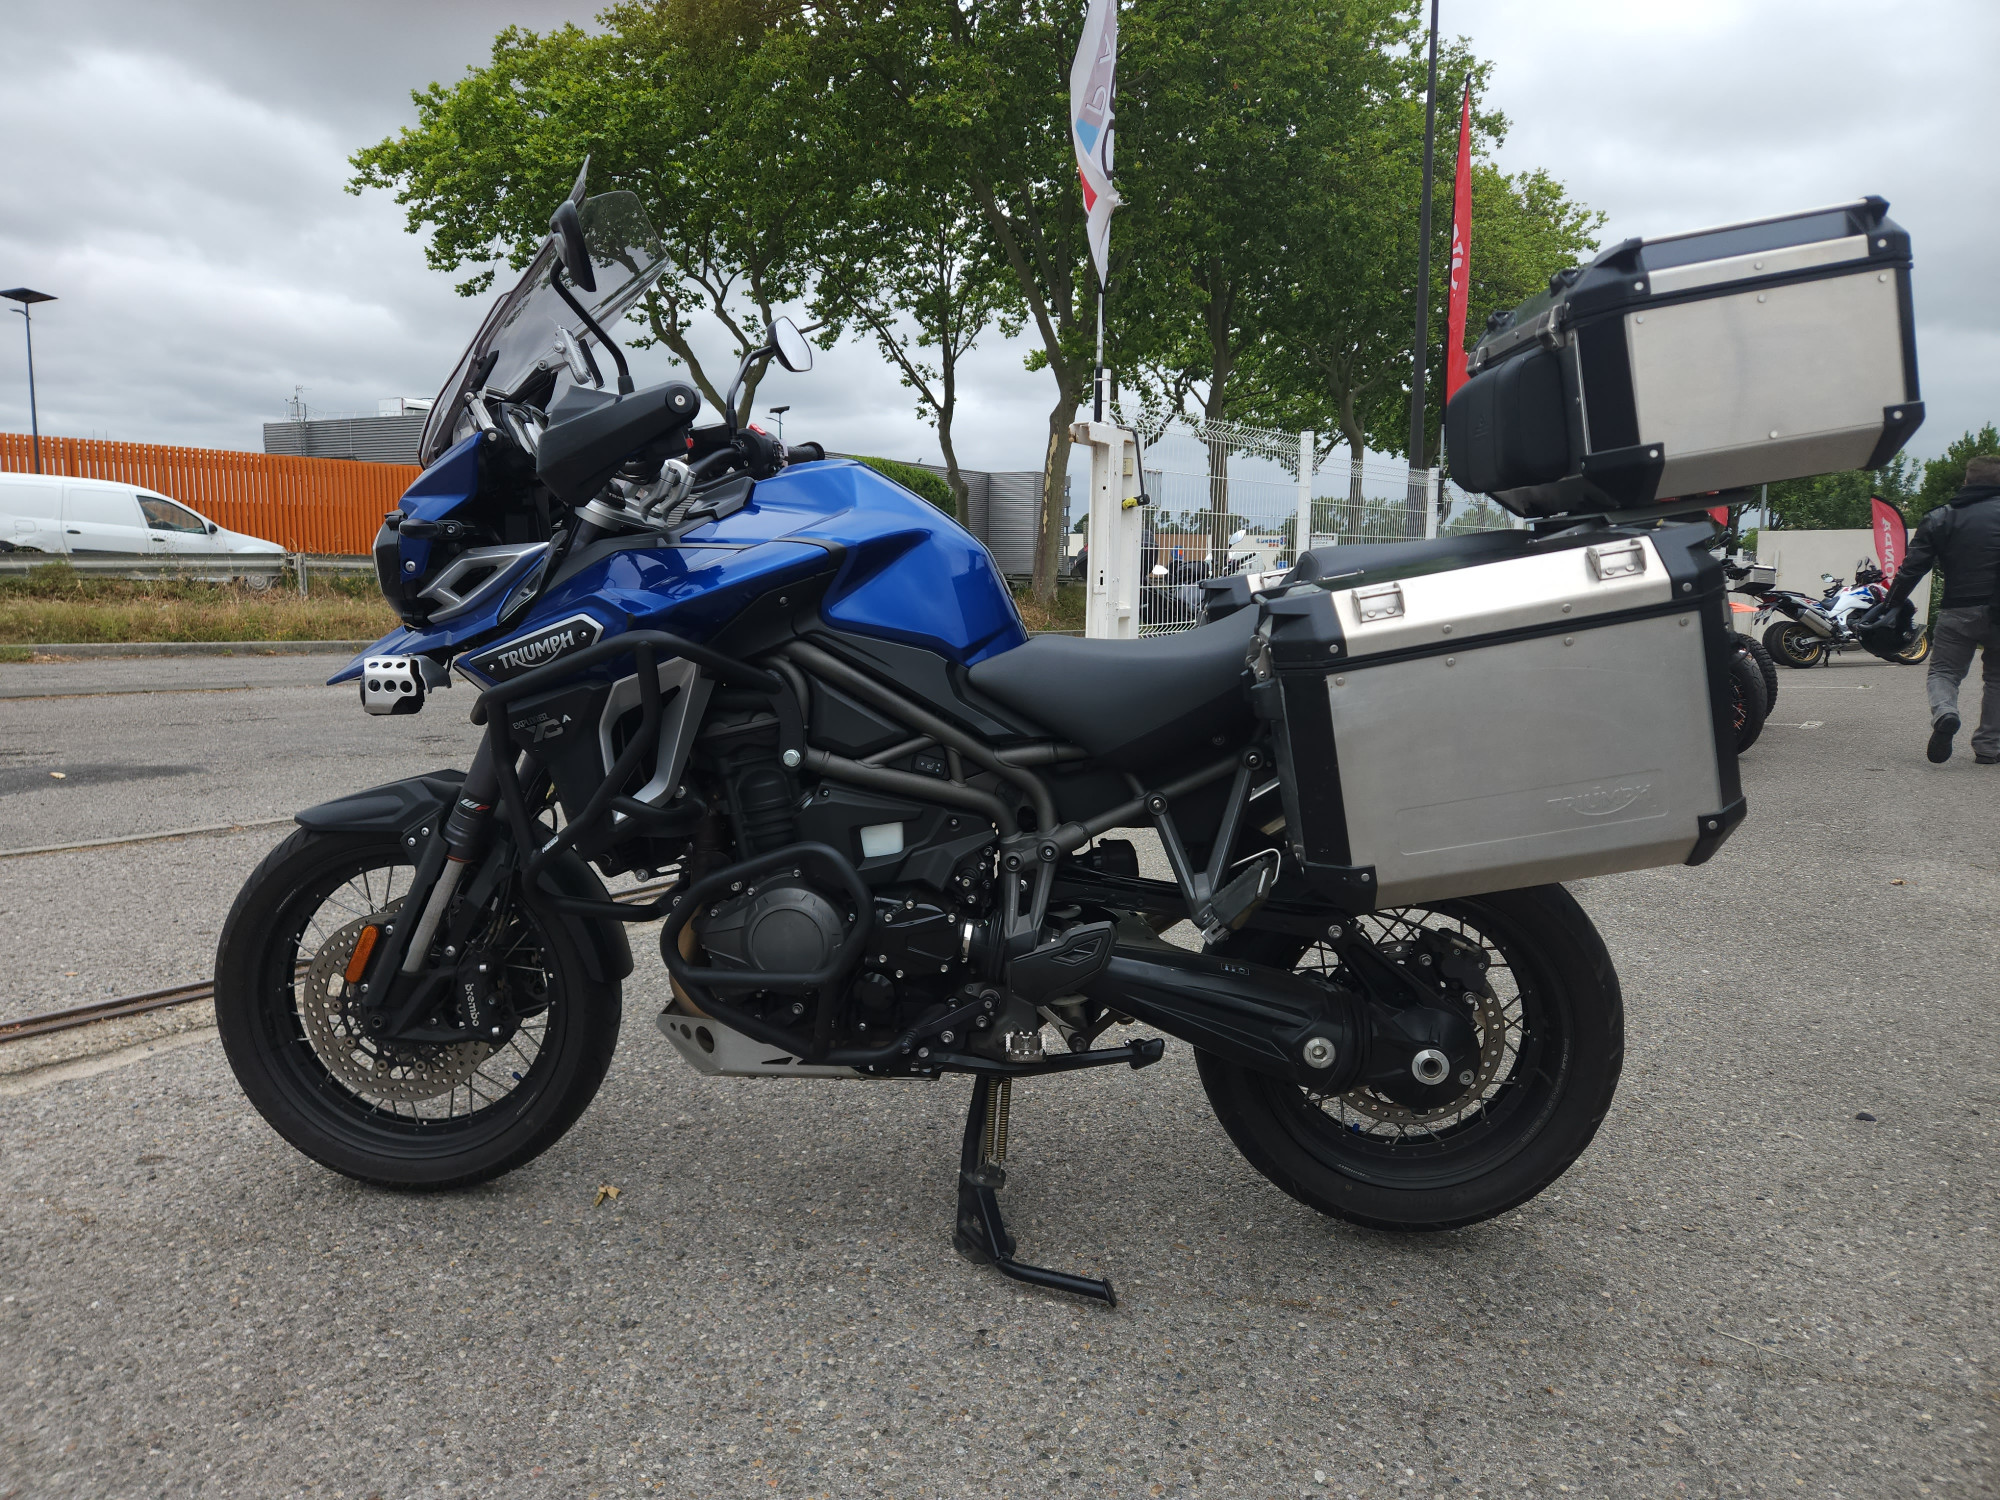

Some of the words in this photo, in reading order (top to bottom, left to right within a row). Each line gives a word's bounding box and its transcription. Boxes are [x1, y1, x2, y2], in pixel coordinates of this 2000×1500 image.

[498, 630, 575, 669] TRIUMPH
[512, 712, 550, 730] EXPLORER
[1546, 783, 1652, 816] TRIUMPH
[464, 983, 480, 1027] brembo
